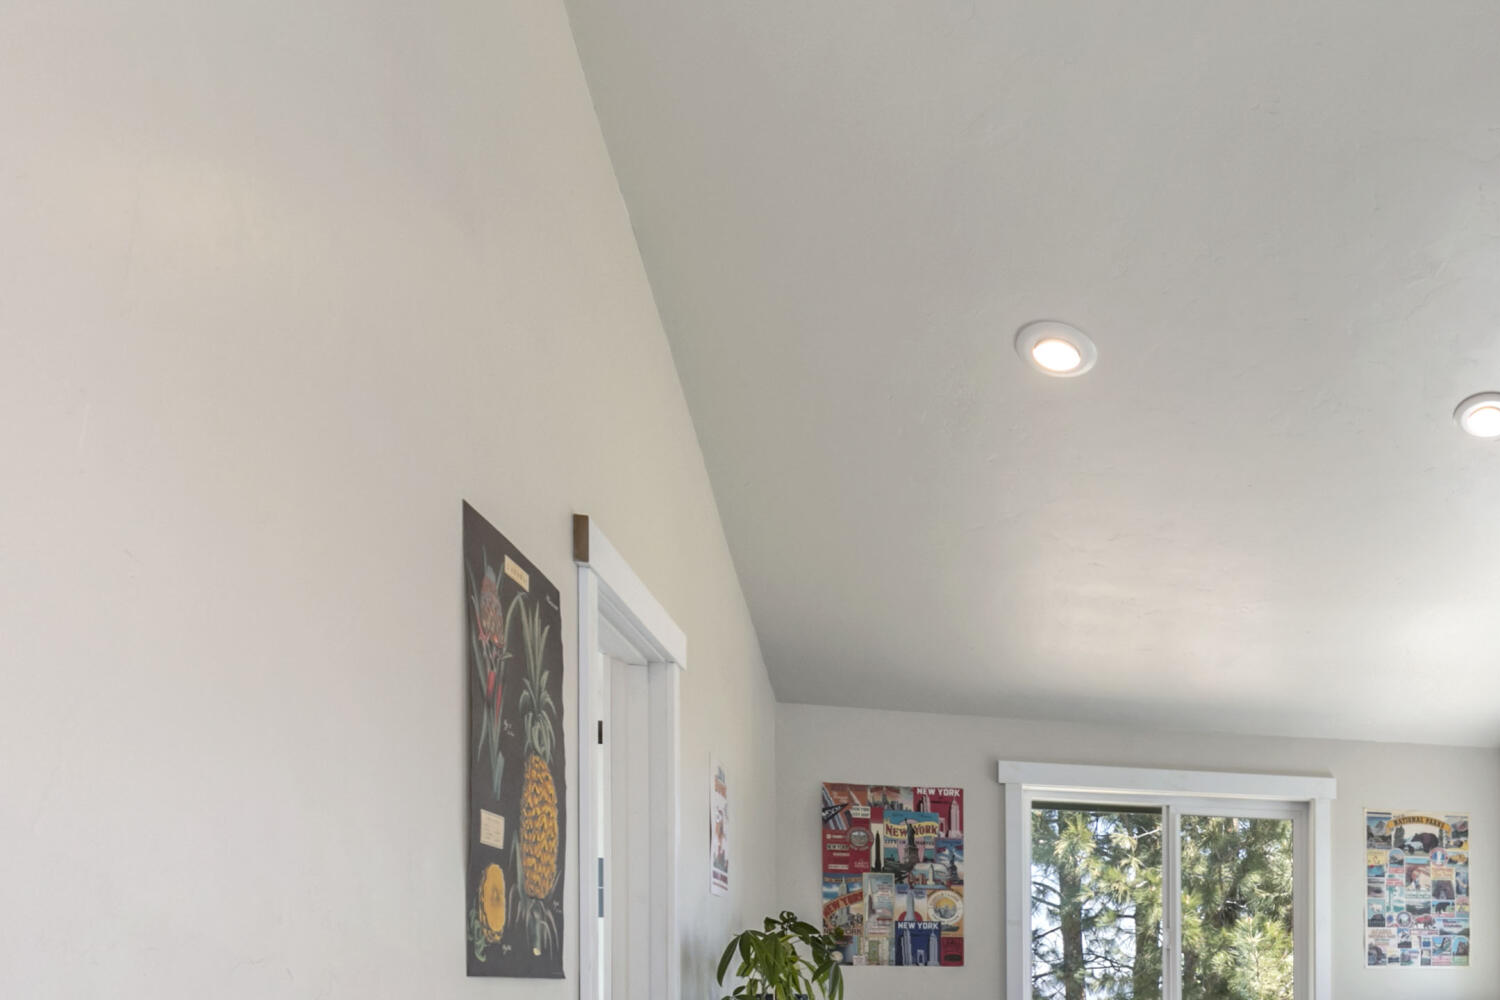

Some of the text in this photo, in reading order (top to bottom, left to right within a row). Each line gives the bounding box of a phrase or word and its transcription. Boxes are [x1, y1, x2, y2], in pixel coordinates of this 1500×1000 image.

[917, 787, 961, 797] NEW YORK
[886, 823, 937, 838] NEW YORK
